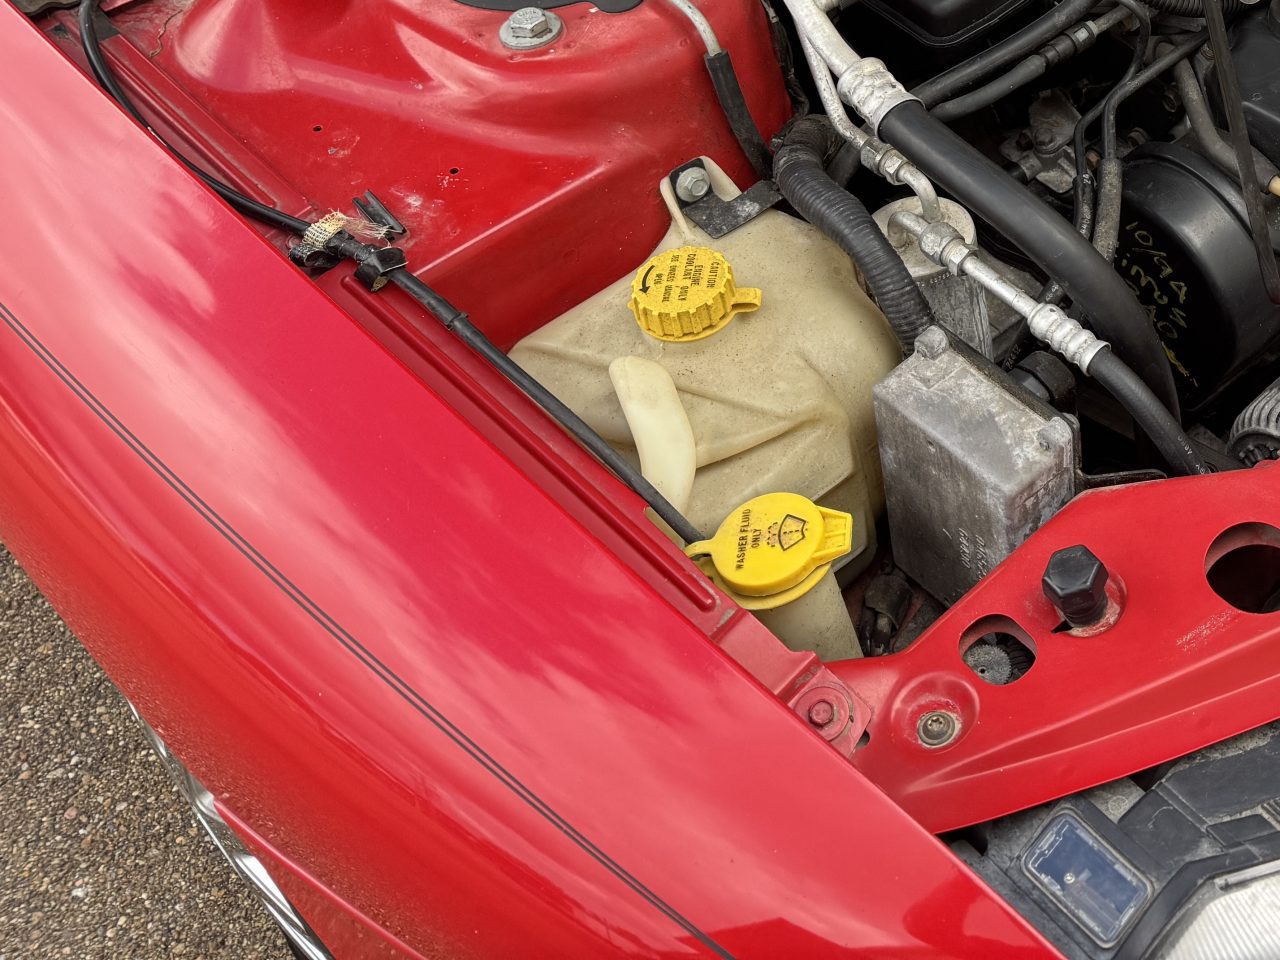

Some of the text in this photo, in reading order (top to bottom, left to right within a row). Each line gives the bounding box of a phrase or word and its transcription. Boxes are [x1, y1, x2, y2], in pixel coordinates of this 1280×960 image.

[678, 253, 697, 301] COOLANT ONLY
[690, 264, 704, 287] ENGINE
[707, 261, 720, 288] CAUTION
[735, 508, 752, 571] WASHER FLUID
[751, 528, 762, 549] ONLY
